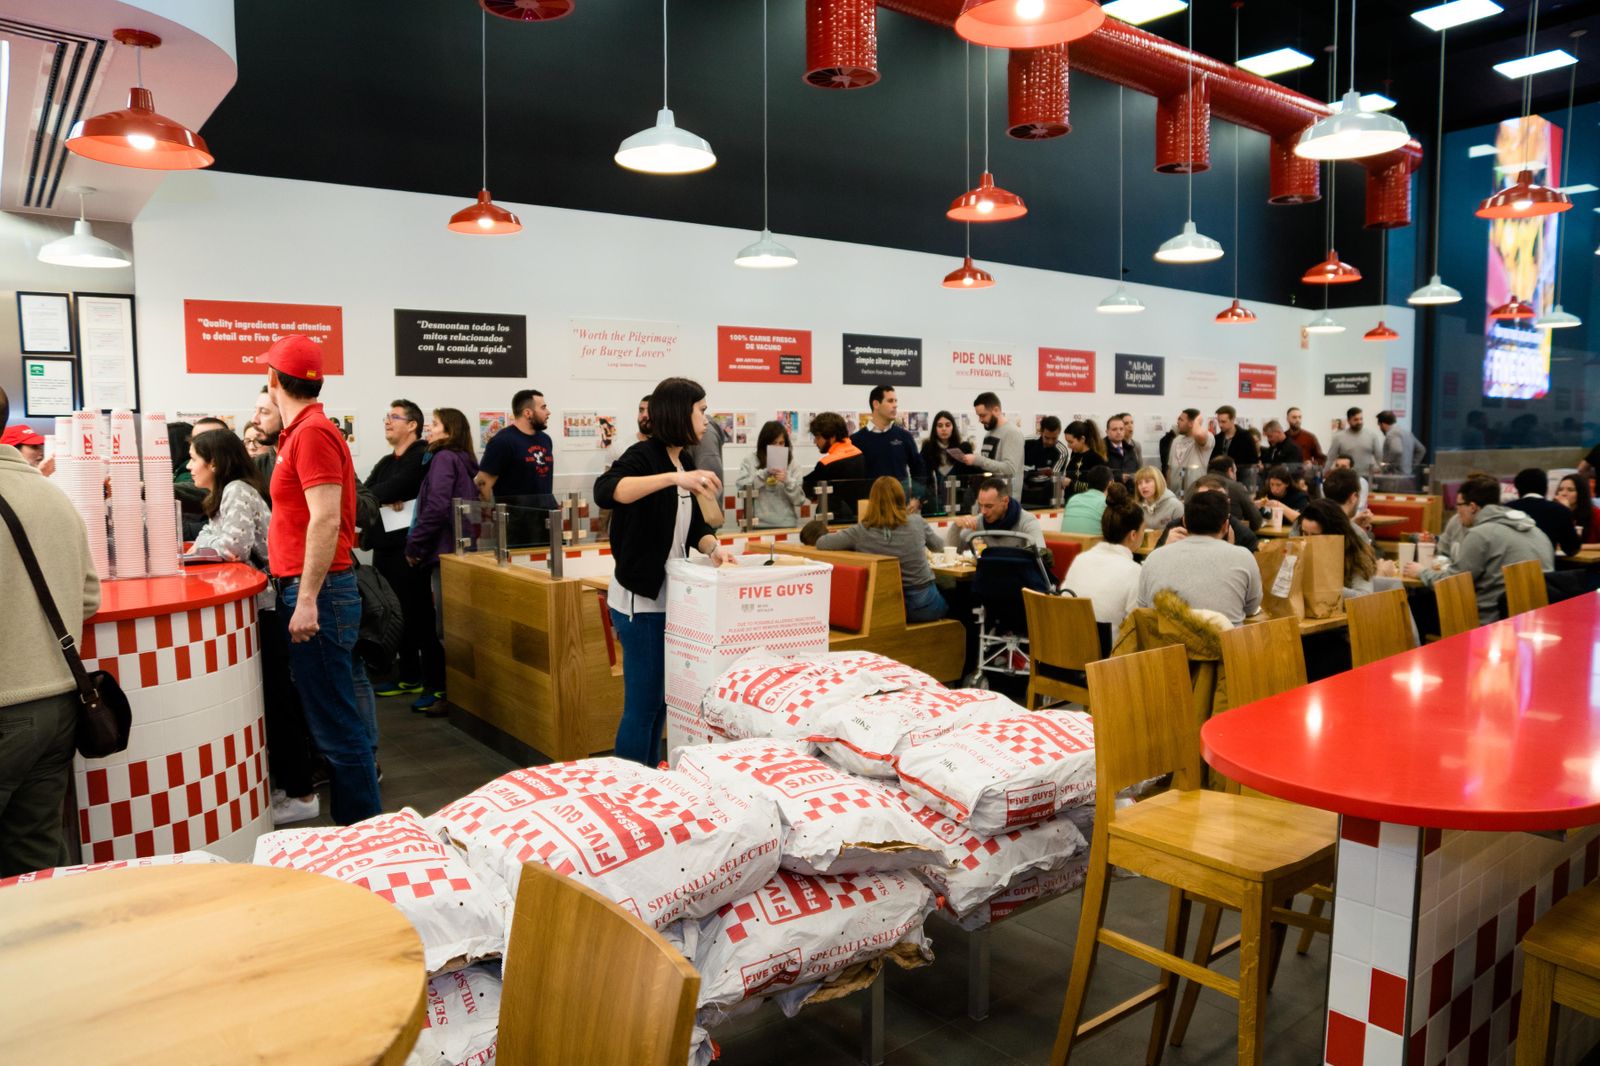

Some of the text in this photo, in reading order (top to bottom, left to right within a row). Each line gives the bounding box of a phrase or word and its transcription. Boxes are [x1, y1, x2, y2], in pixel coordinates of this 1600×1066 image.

[197, 318, 332, 332] "Quality ingredients and attention
[417, 320, 510, 332] "Desmontan todos los
[202, 332, 212, 340] to
[213, 332, 237, 341] detail
[239, 334, 252, 342] are
[254, 333, 270, 342] Five
[423, 332, 503, 342] mitos relacionados
[573, 328, 678, 345] "Worth the Pilgrimage
[749, 335, 771, 343] CARNE
[772, 336, 797, 344] FRESCA
[436, 343, 445, 351] la
[447, 344, 478, 352] comida
[480, 344, 512, 354] rápida"
[581, 345, 672, 359] for Burger Lovers"
[756, 343, 782, 351] VACUNO
[883, 347, 907, 356] wrapped
[908, 347, 914, 355] in
[856, 356, 875, 366] simple
[875, 356, 891, 365] silver
[952, 351, 1012, 366] PIDE ONLINE
[1128, 361, 1153, 371] "All-Out
[1125, 370, 1156, 382] Enjoyable"
[739, 583, 814, 599] FIVE GUYS
[748, 671, 781, 704] SELECT
[765, 681, 800, 706] GUYS
[785, 771, 835, 789] GUYS
[498, 787, 527, 807] FIVE
[1032, 789, 1054, 801] GUYS
[611, 809, 652, 852] FRESH
[576, 822, 618, 868] FIVE
[336, 842, 440, 878] FIVE GU
[647, 838, 778, 913] SPECIALLY SELECTED
[764, 879, 793, 918] FIV
[792, 873, 822, 910] FRES
[1014, 886, 1039, 896] GUYS
[654, 908, 679, 929] FOR
[711, 871, 743, 895] GUYS
[810, 936, 872, 963] SPECIALLY
[745, 969, 769, 985] FIVE
[771, 957, 798, 974] GUYS
